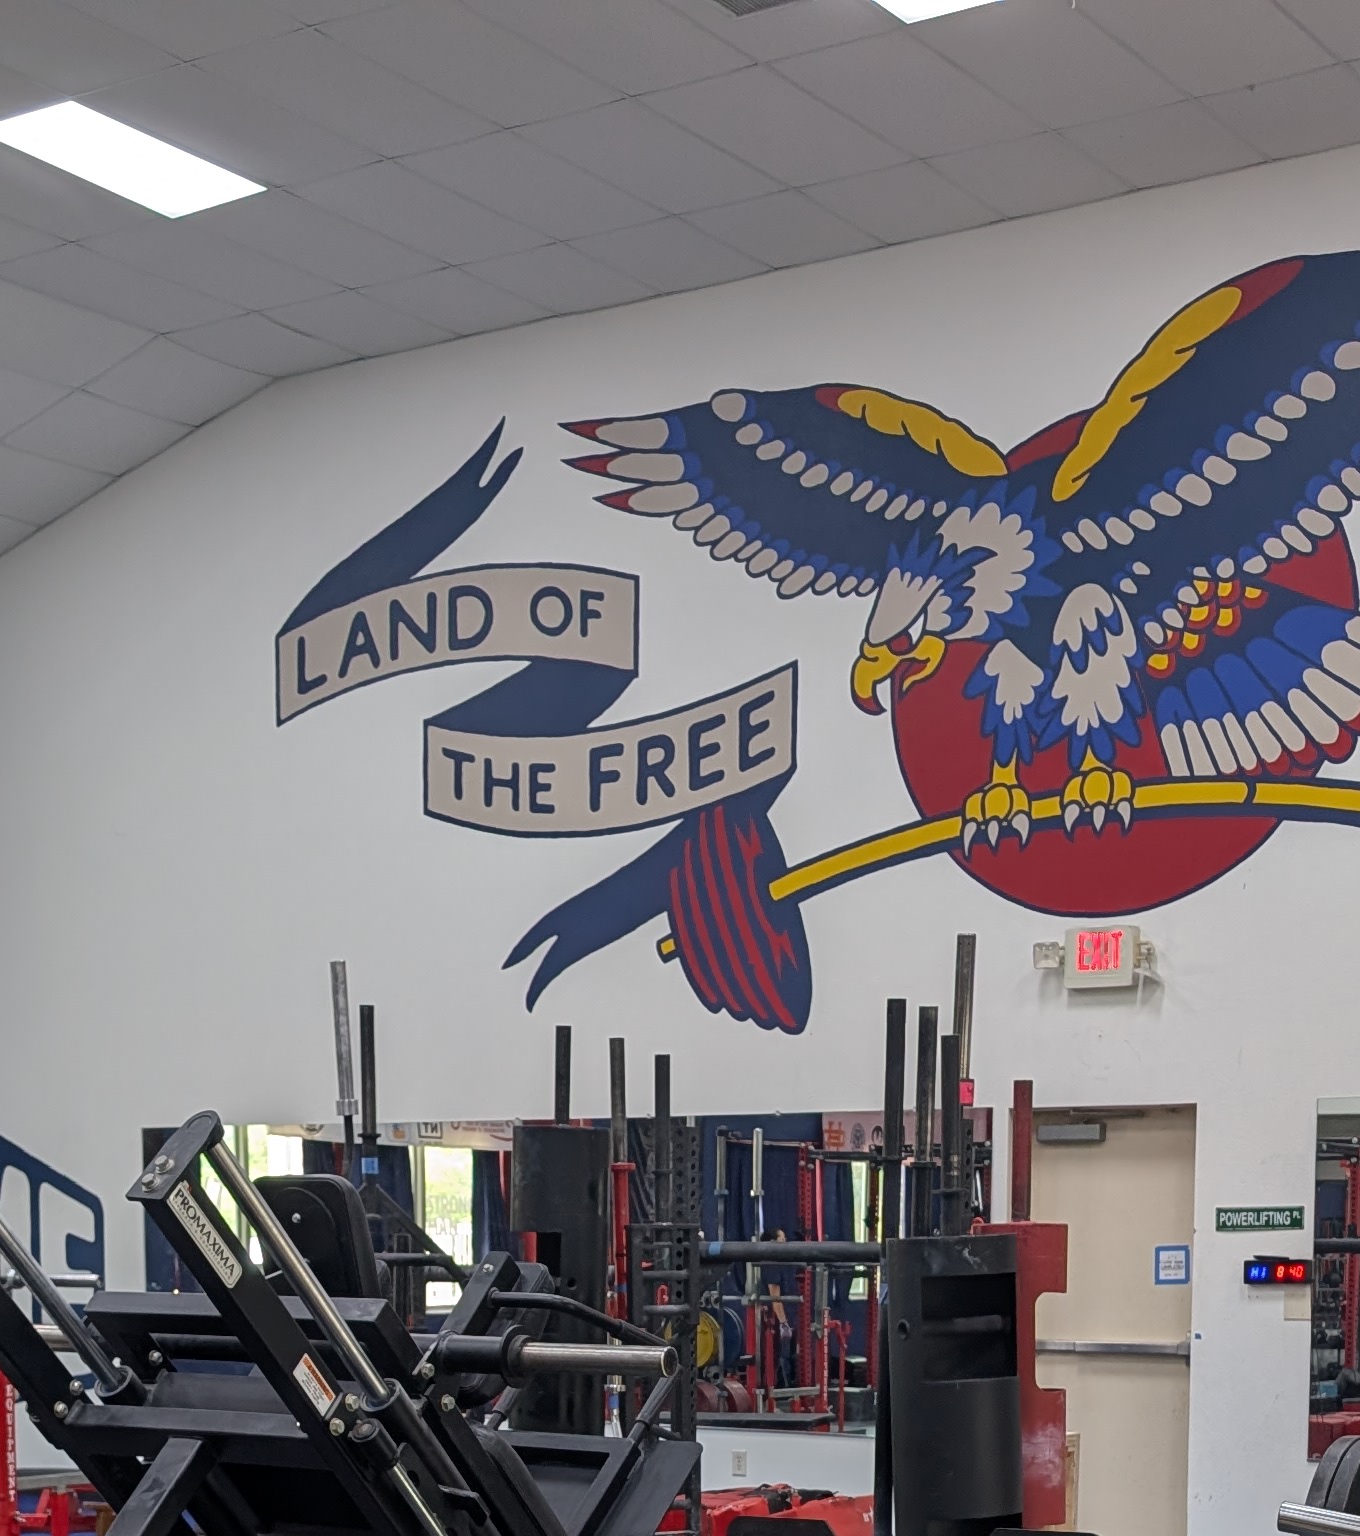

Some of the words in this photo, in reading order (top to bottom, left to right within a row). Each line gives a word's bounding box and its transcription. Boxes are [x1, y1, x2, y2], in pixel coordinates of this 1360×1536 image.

[296, 585, 493, 695] LAND
[529, 586, 605, 638] OF
[441, 747, 556, 815] THE
[588, 690, 776, 813] FREE
[1077, 930, 1123, 971] EXIT
[174, 1189, 236, 1277] PROMAXIMA
[1219, 1210, 1291, 1227] POWERLIFTING
[1292, 1211, 1301, 1219] PL
[6, 1384, 16, 1502] EQUIPMENT
